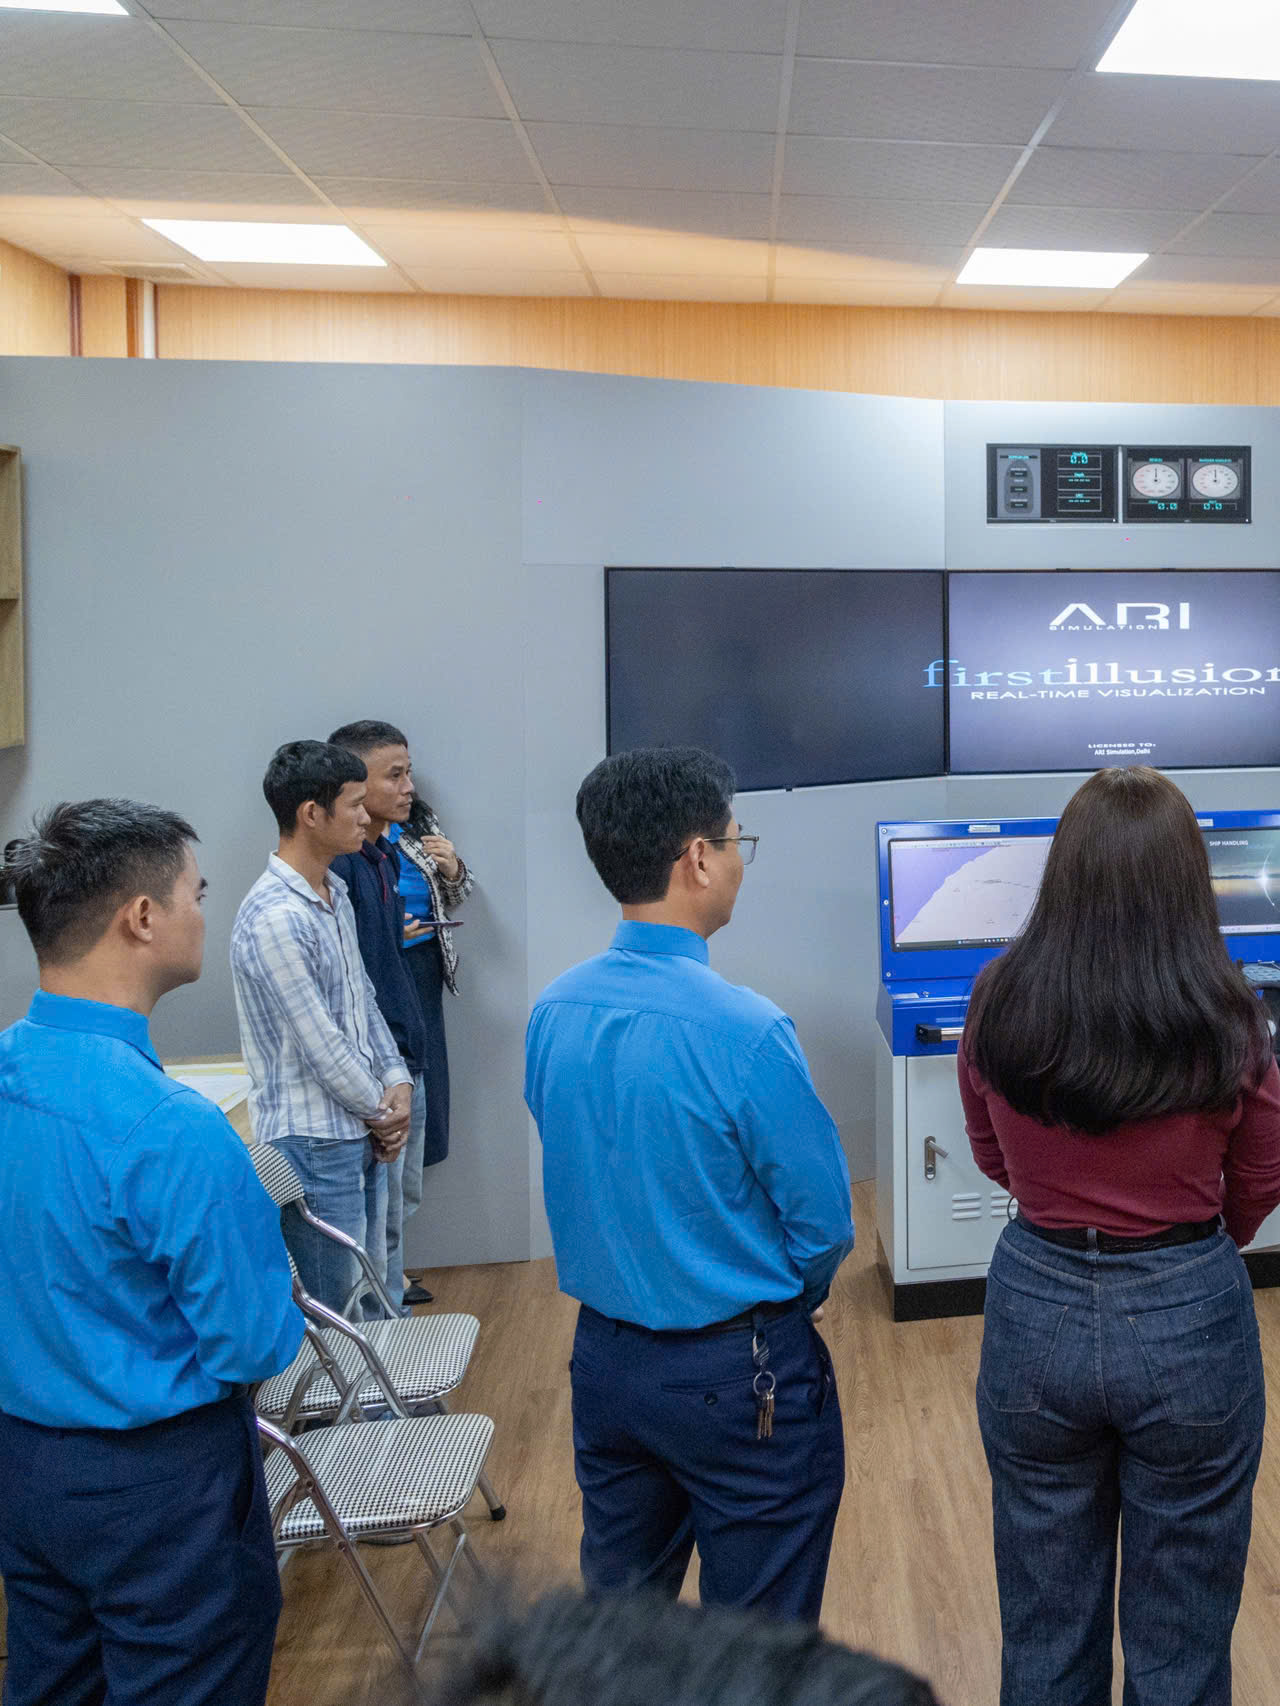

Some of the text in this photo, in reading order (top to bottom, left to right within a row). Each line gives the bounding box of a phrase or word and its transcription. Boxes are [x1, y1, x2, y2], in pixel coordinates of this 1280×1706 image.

[1049, 602, 1190, 630] ARI
[971, 687, 1266, 700] REAL-TIME VISUALIZATION
